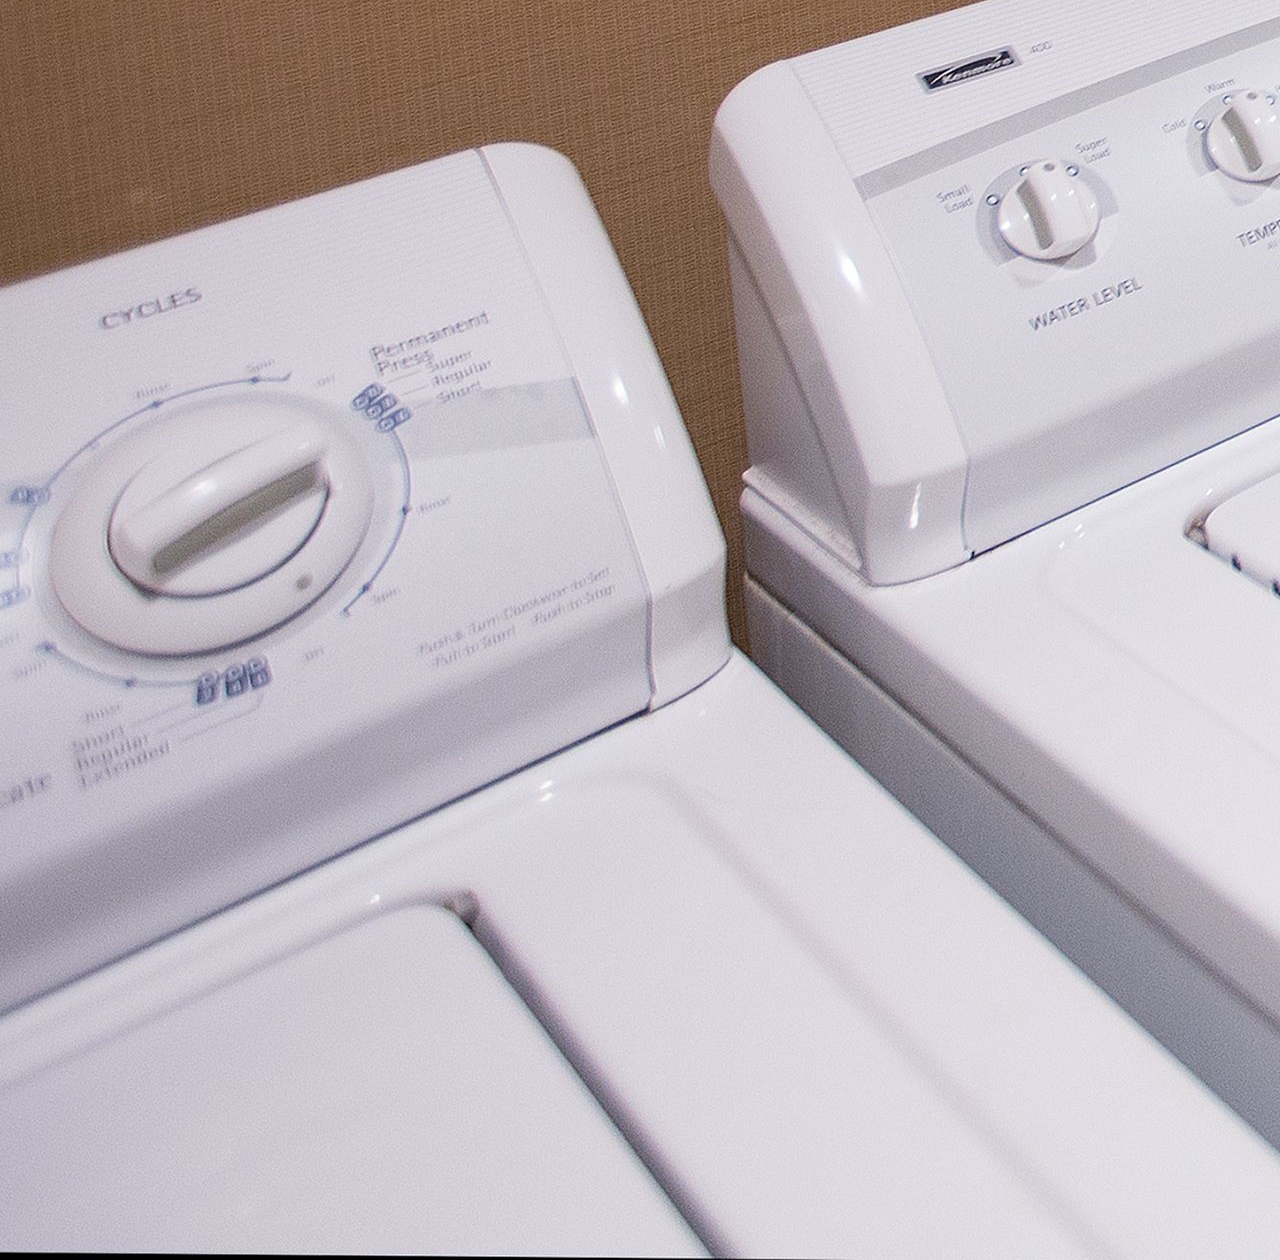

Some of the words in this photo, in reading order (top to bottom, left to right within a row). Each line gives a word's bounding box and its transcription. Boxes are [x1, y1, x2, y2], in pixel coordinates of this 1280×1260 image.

[936, 184, 970, 203] Small
[100, 288, 202, 330] CYCLES
[1028, 297, 1091, 331] WATER
[1092, 277, 1143, 307] LEVEL
[370, 310, 490, 361] Permanent
[375, 350, 434, 376] Press
